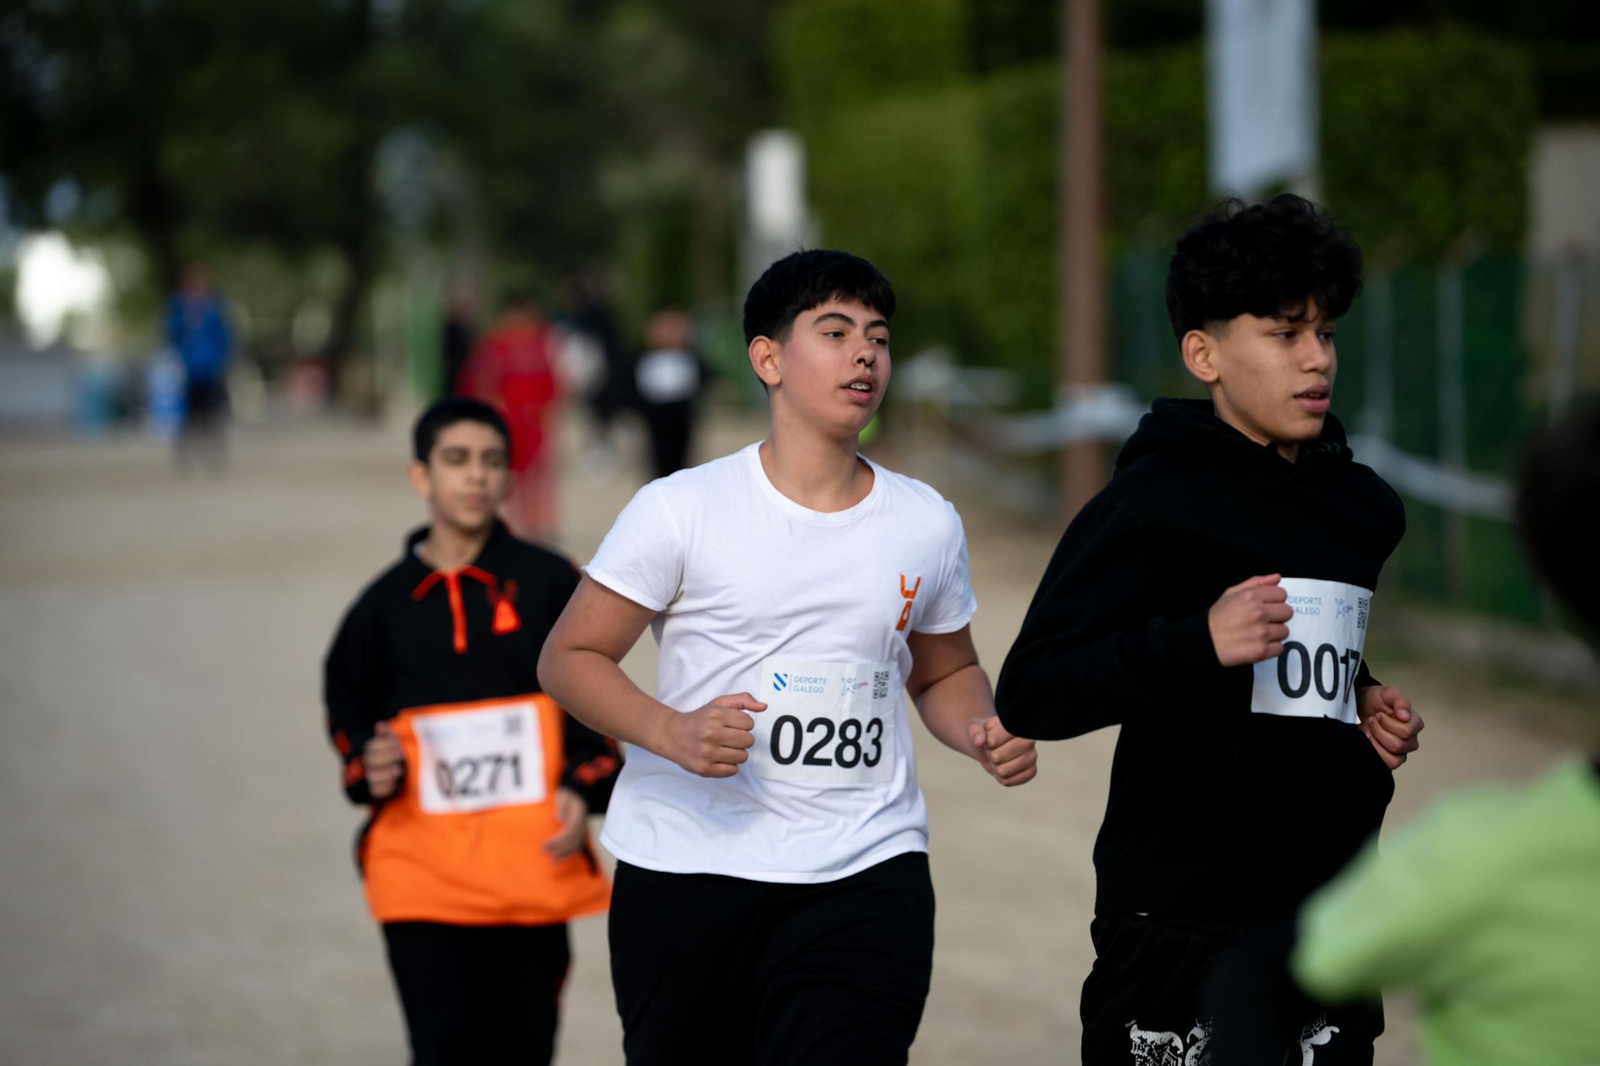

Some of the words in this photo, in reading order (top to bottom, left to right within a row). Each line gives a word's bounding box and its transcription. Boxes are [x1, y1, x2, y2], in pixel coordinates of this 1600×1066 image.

[1292, 607, 1320, 615] ALEGO
[794, 676, 828, 685] DEPORTE
[1277, 641, 1361, 704] 0017
[793, 685, 824, 694] GALEGO
[770, 715, 884, 769] 0283
[435, 752, 522, 799] 0271
